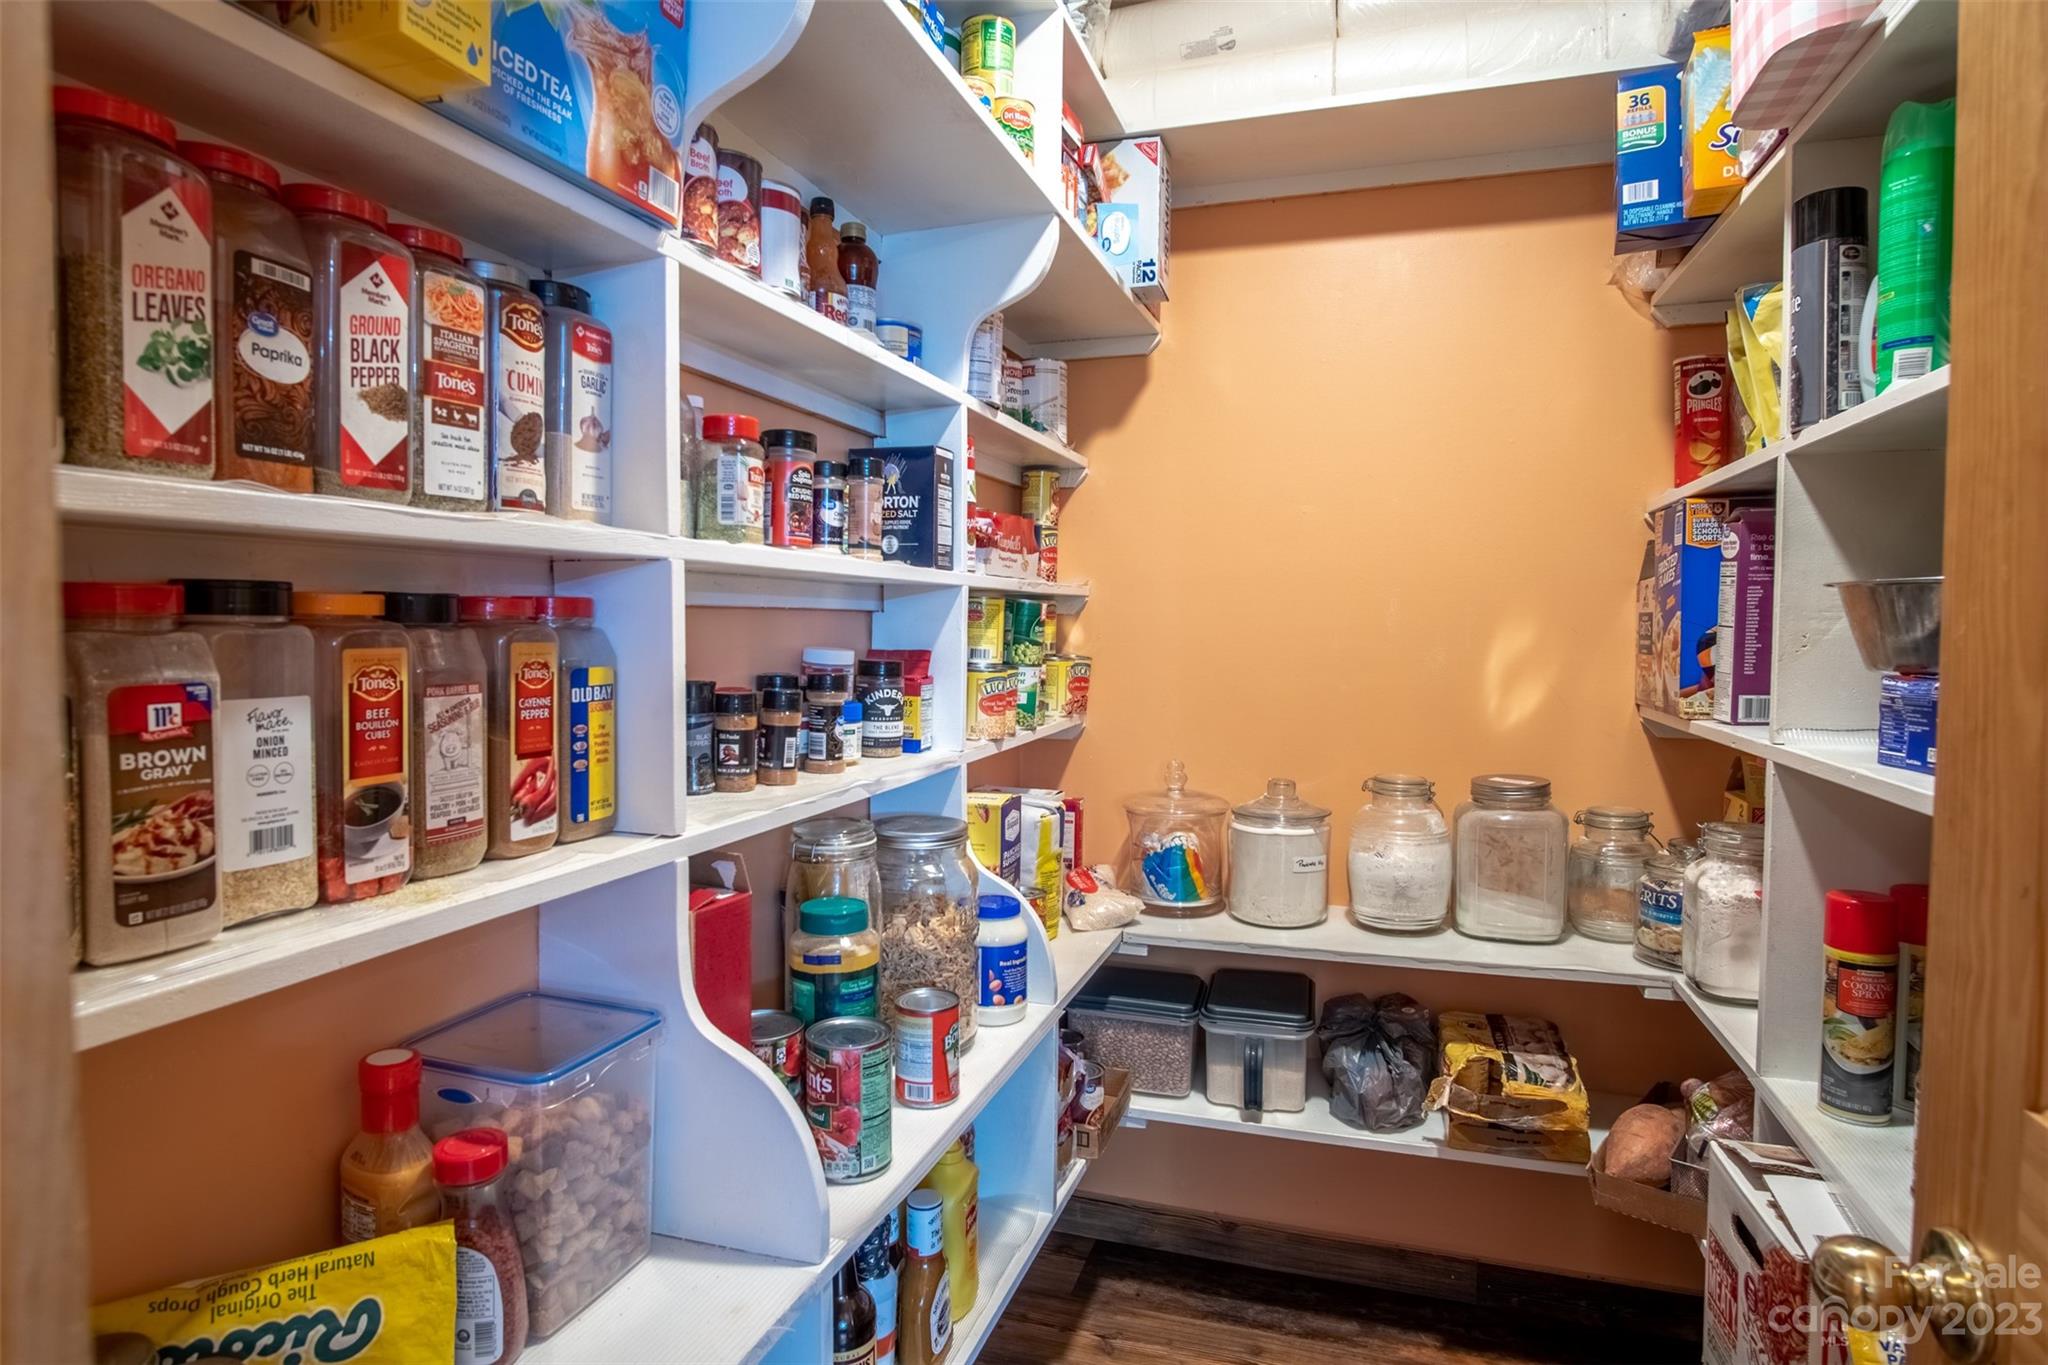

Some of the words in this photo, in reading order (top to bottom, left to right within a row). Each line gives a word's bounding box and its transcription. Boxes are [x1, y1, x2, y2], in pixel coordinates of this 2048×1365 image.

[492, 40, 538, 84] ICED
[541, 69, 573, 107] TEA
[492, 66, 524, 91] PICKED
[525, 87, 535, 96] AT
[537, 93, 551, 107] THE
[552, 102, 573, 121] PEAK
[1629, 92, 1650, 108] 36
[503, 83, 515, 95] OF
[516, 91, 562, 125] FRESHNESS
[1622, 126, 1657, 137] BONUS
[716, 179, 733, 188] eef
[132, 264, 206, 293] OREGANO
[1142, 258, 1156, 283] 12
[132, 291, 206, 324] LEAVES
[350, 314, 401, 336] GROUND
[433, 337, 479, 355] SPAGHETTI
[440, 329, 474, 345] ITALIAN
[251, 342, 303, 368] Paprika
[351, 338, 400, 363] BLACK
[351, 366, 400, 388] PEPPER
[435, 371, 476, 396] Tone's
[507, 369, 543, 398] CUMIN
[581, 375, 607, 395] GARLIC
[1686, 396, 1722, 415] PRINGLES
[881, 495, 919, 509] RTON
[897, 509, 918, 518] SALT
[1692, 534, 1723, 542] SPORTS
[523, 668, 549, 680] Tone's
[359, 676, 396, 692] Tone's
[518, 696, 552, 708] CAYENNE
[571, 686, 592, 703] OLD
[593, 685, 612, 701] BAY
[246, 707, 284, 724] Flavor
[365, 708, 391, 719] BEEF
[520, 708, 550, 720] PEPPER
[355, 719, 399, 731] BOUILLON
[256, 735, 285, 748] ONION
[365, 730, 391, 740] CUBES
[119, 745, 206, 771] BROWN
[253, 746, 288, 760] MINCED
[140, 764, 193, 780] GRAVY
[1841, 979, 1894, 993] COOKING
[1851, 990, 1887, 1000] SPRAY
[807, 1072, 833, 1094] nt's
[315, 1251, 375, 1278] Natural
[268, 1267, 309, 1287] Herb
[206, 1278, 262, 1303] Cough
[288, 1284, 318, 1303] The
[148, 1296, 201, 1314] Drops
[210, 1292, 282, 1324] Original
